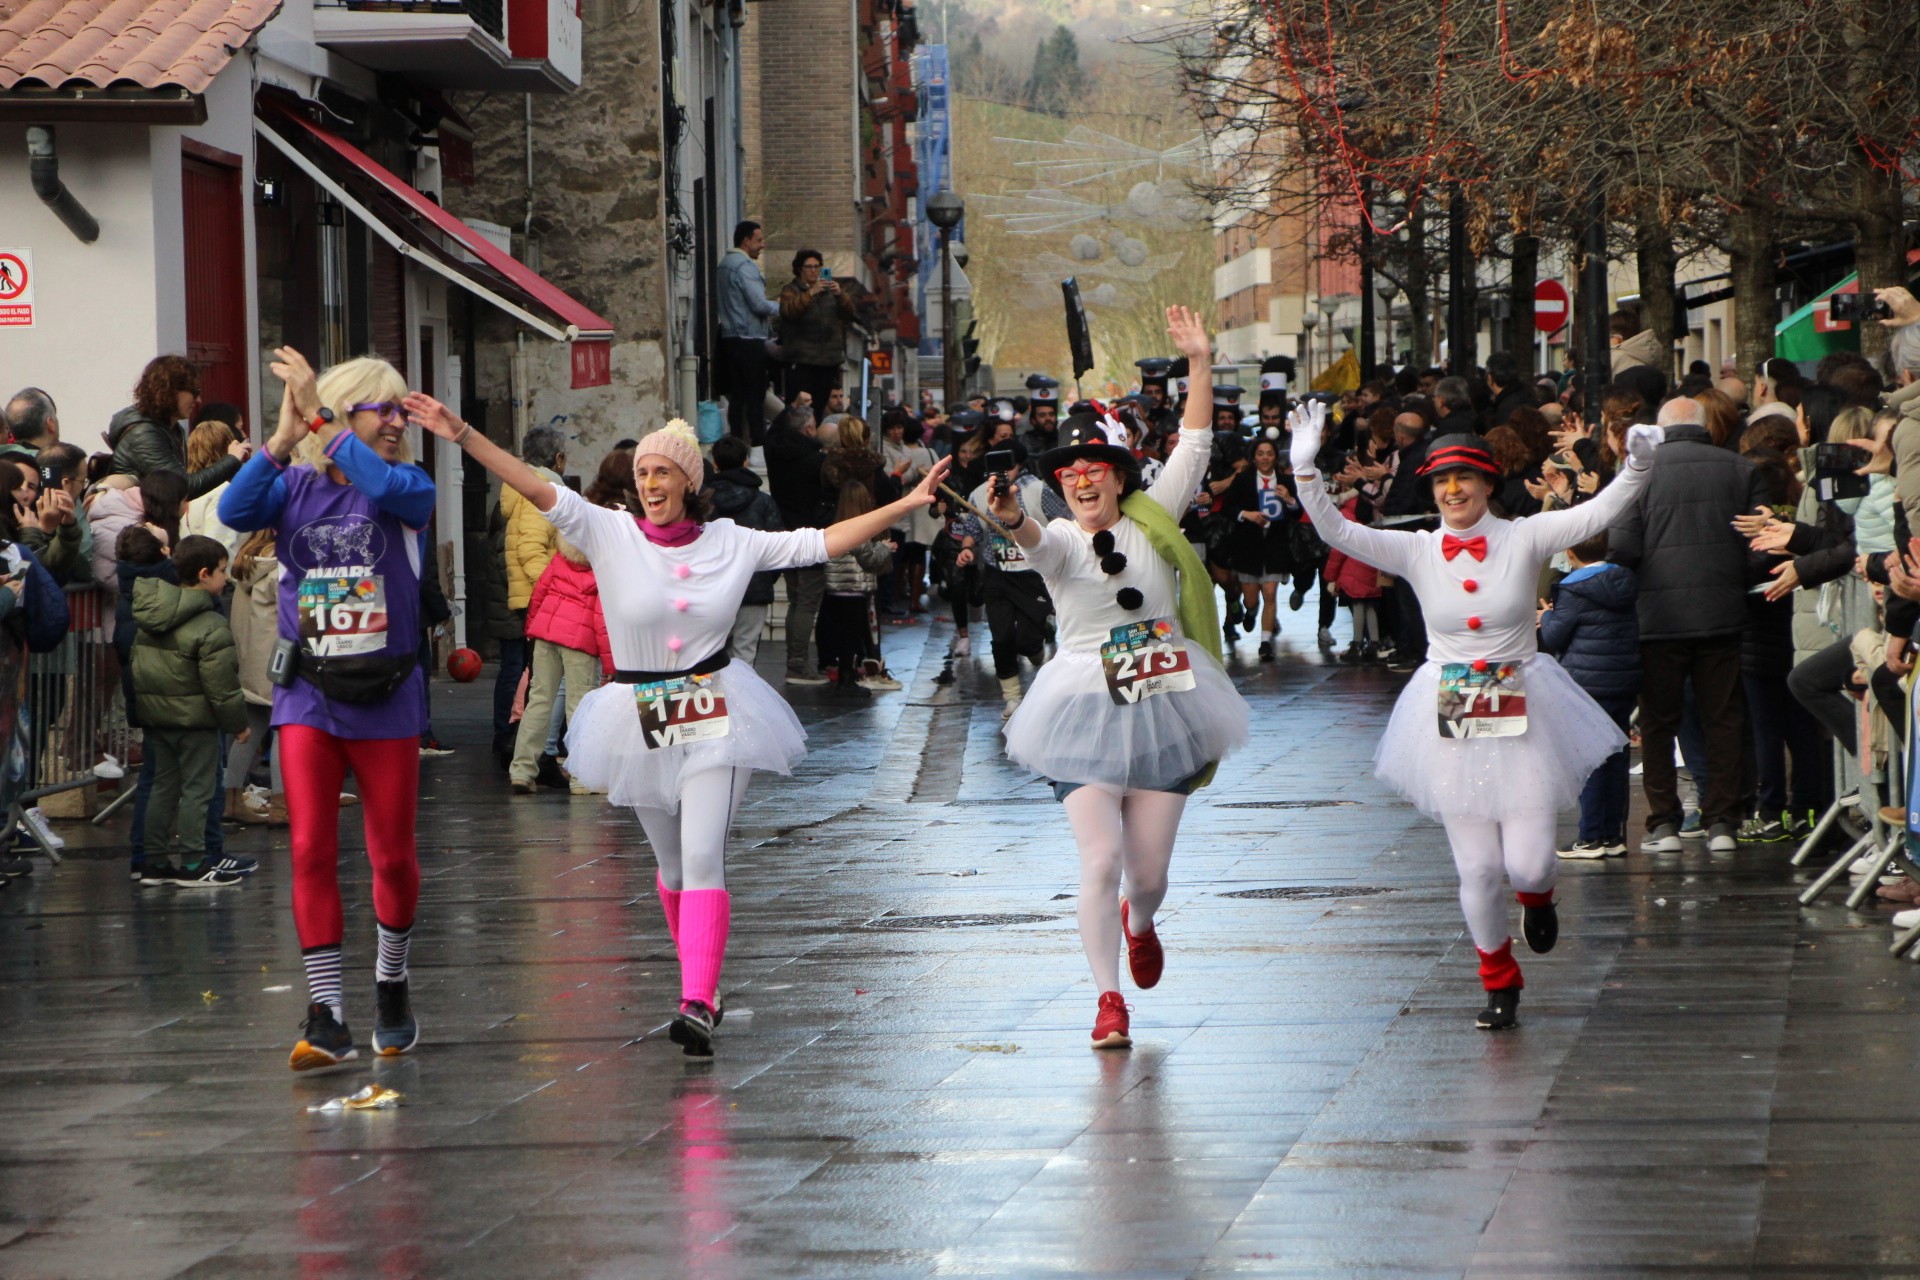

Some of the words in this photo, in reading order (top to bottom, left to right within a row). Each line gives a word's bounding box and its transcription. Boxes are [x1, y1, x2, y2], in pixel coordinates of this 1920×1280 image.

[1263, 490, 1283, 518] 5
[309, 602, 375, 631] 167
[1113, 642, 1178, 681] 273
[649, 688, 715, 722] 170
[1459, 686, 1500, 713] 71
